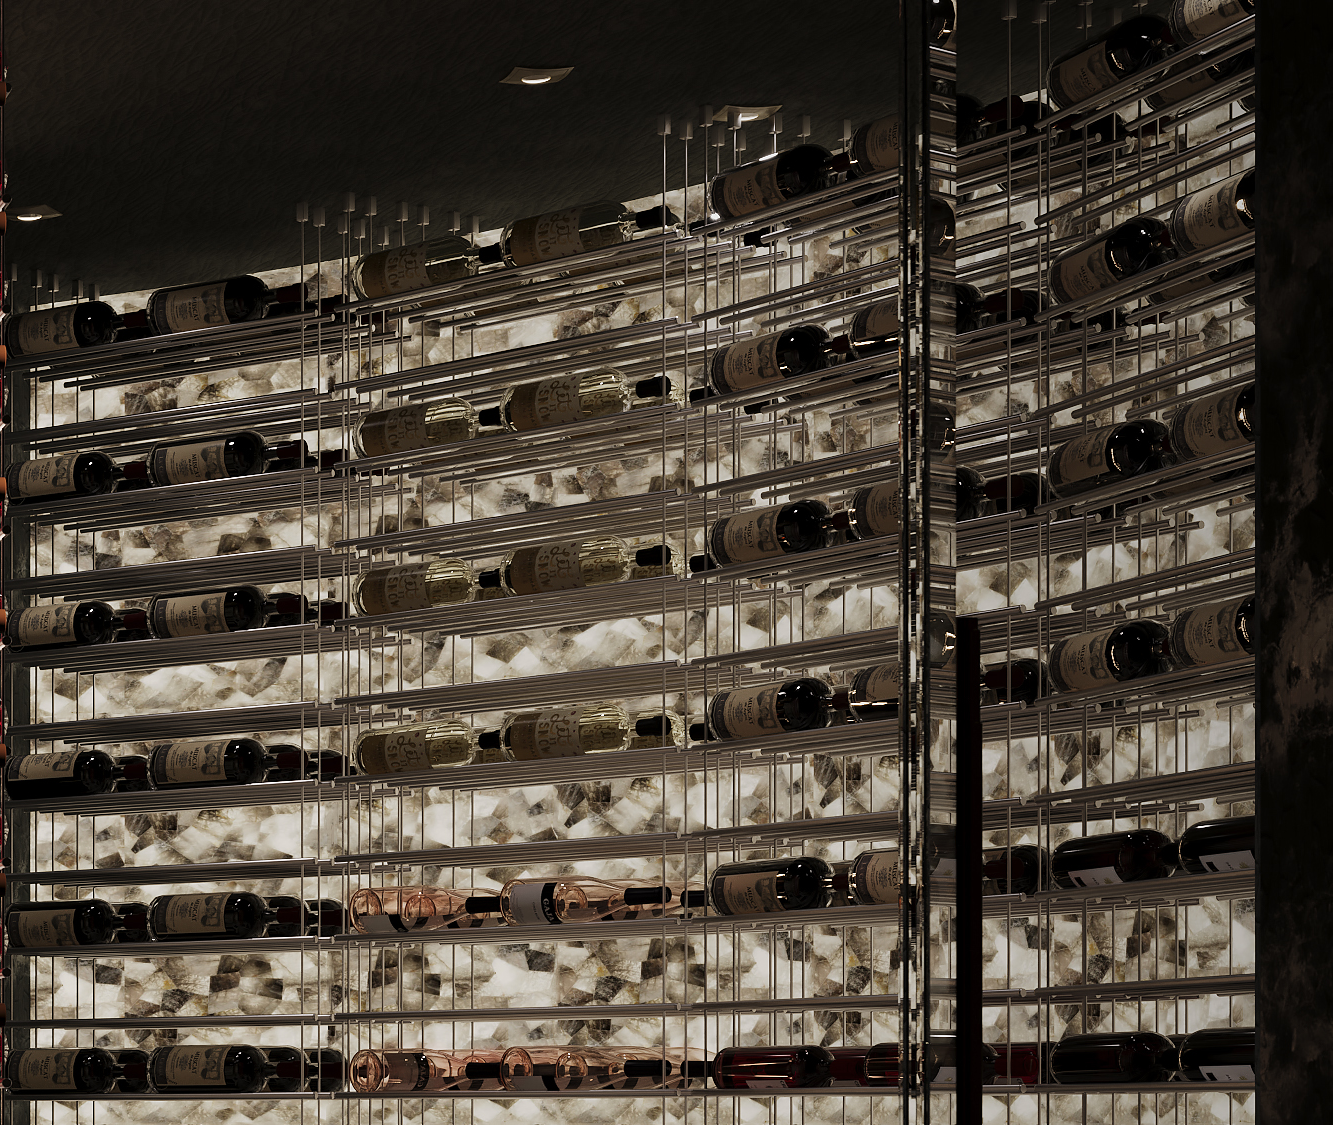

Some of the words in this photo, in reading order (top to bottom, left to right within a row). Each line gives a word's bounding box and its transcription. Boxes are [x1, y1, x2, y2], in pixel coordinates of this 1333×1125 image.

[537, 220, 552, 256] SNOW
[549, 213, 572, 246] Let
[388, 257, 401, 289] SNOW
[399, 248, 420, 279] Let
[537, 388, 551, 423] SNOW
[549, 380, 572, 413] Let
[386, 414, 398, 449] SNOW
[398, 409, 421, 440] Let
[537, 554, 551, 587] SNOW
[549, 546, 572, 579] Let
[387, 573, 399, 610] SNOW
[398, 569, 420, 601] Let
[538, 722, 552, 754] SNOW
[550, 714, 573, 746] Let
[397, 736, 421, 767] Let
[543, 898, 555, 921] GAJA
